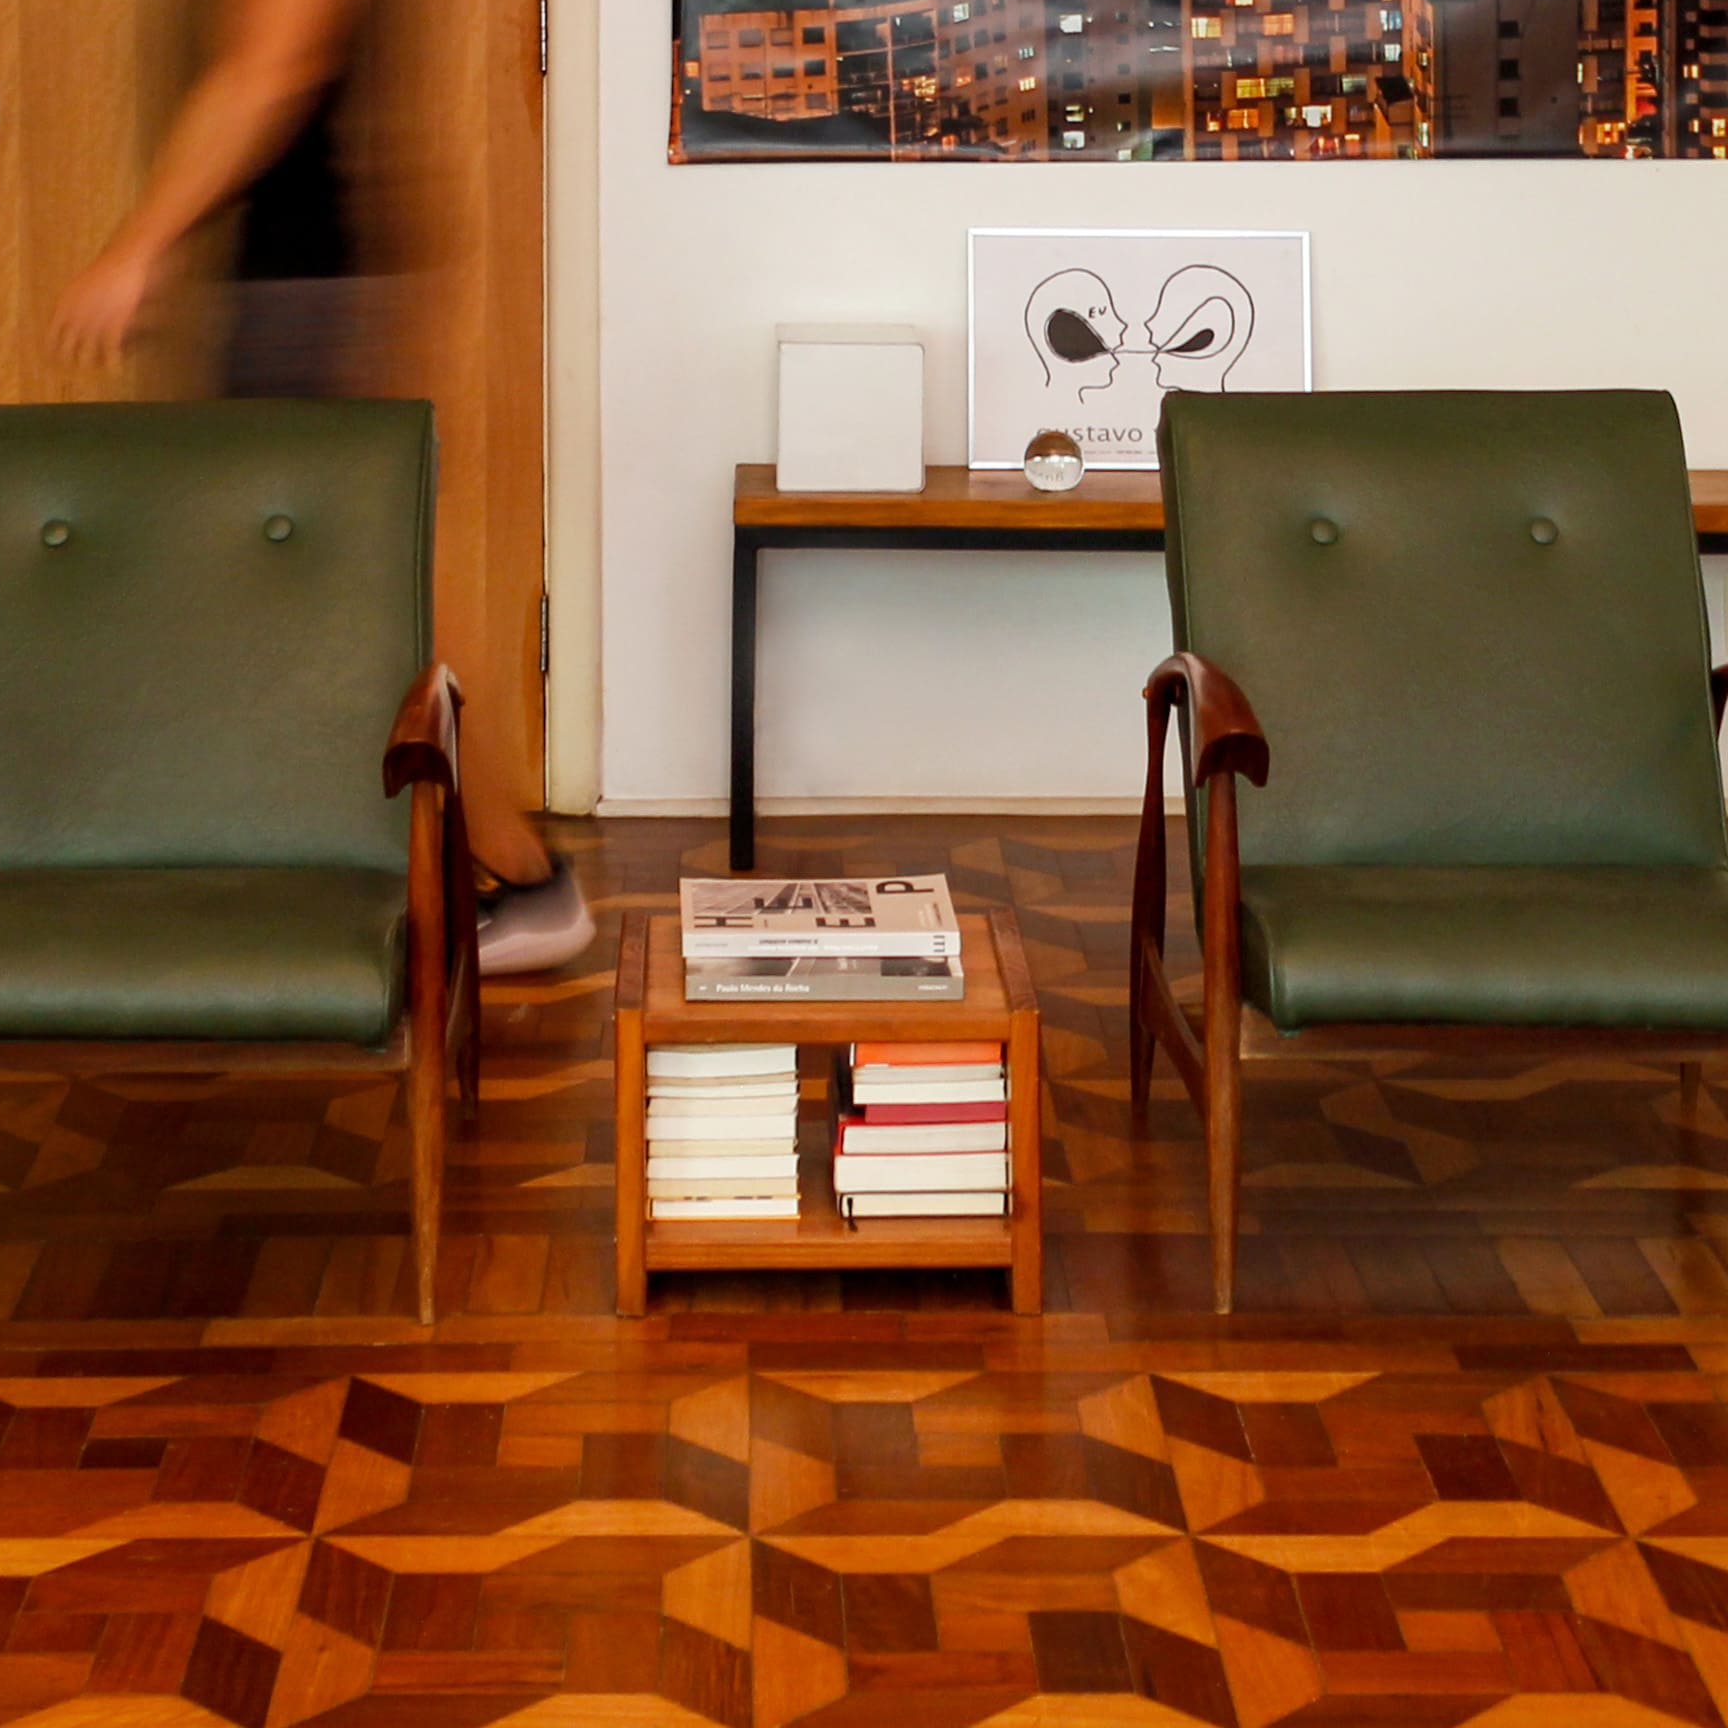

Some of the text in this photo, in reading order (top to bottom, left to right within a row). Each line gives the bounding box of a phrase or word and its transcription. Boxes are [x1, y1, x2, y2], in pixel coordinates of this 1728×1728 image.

[1036, 426, 1143, 442] stavo
[715, 984, 739, 993] Paulo
[740, 984, 771, 993] Mendes
[773, 984, 783, 993] da
[785, 984, 811, 993] Rocha
